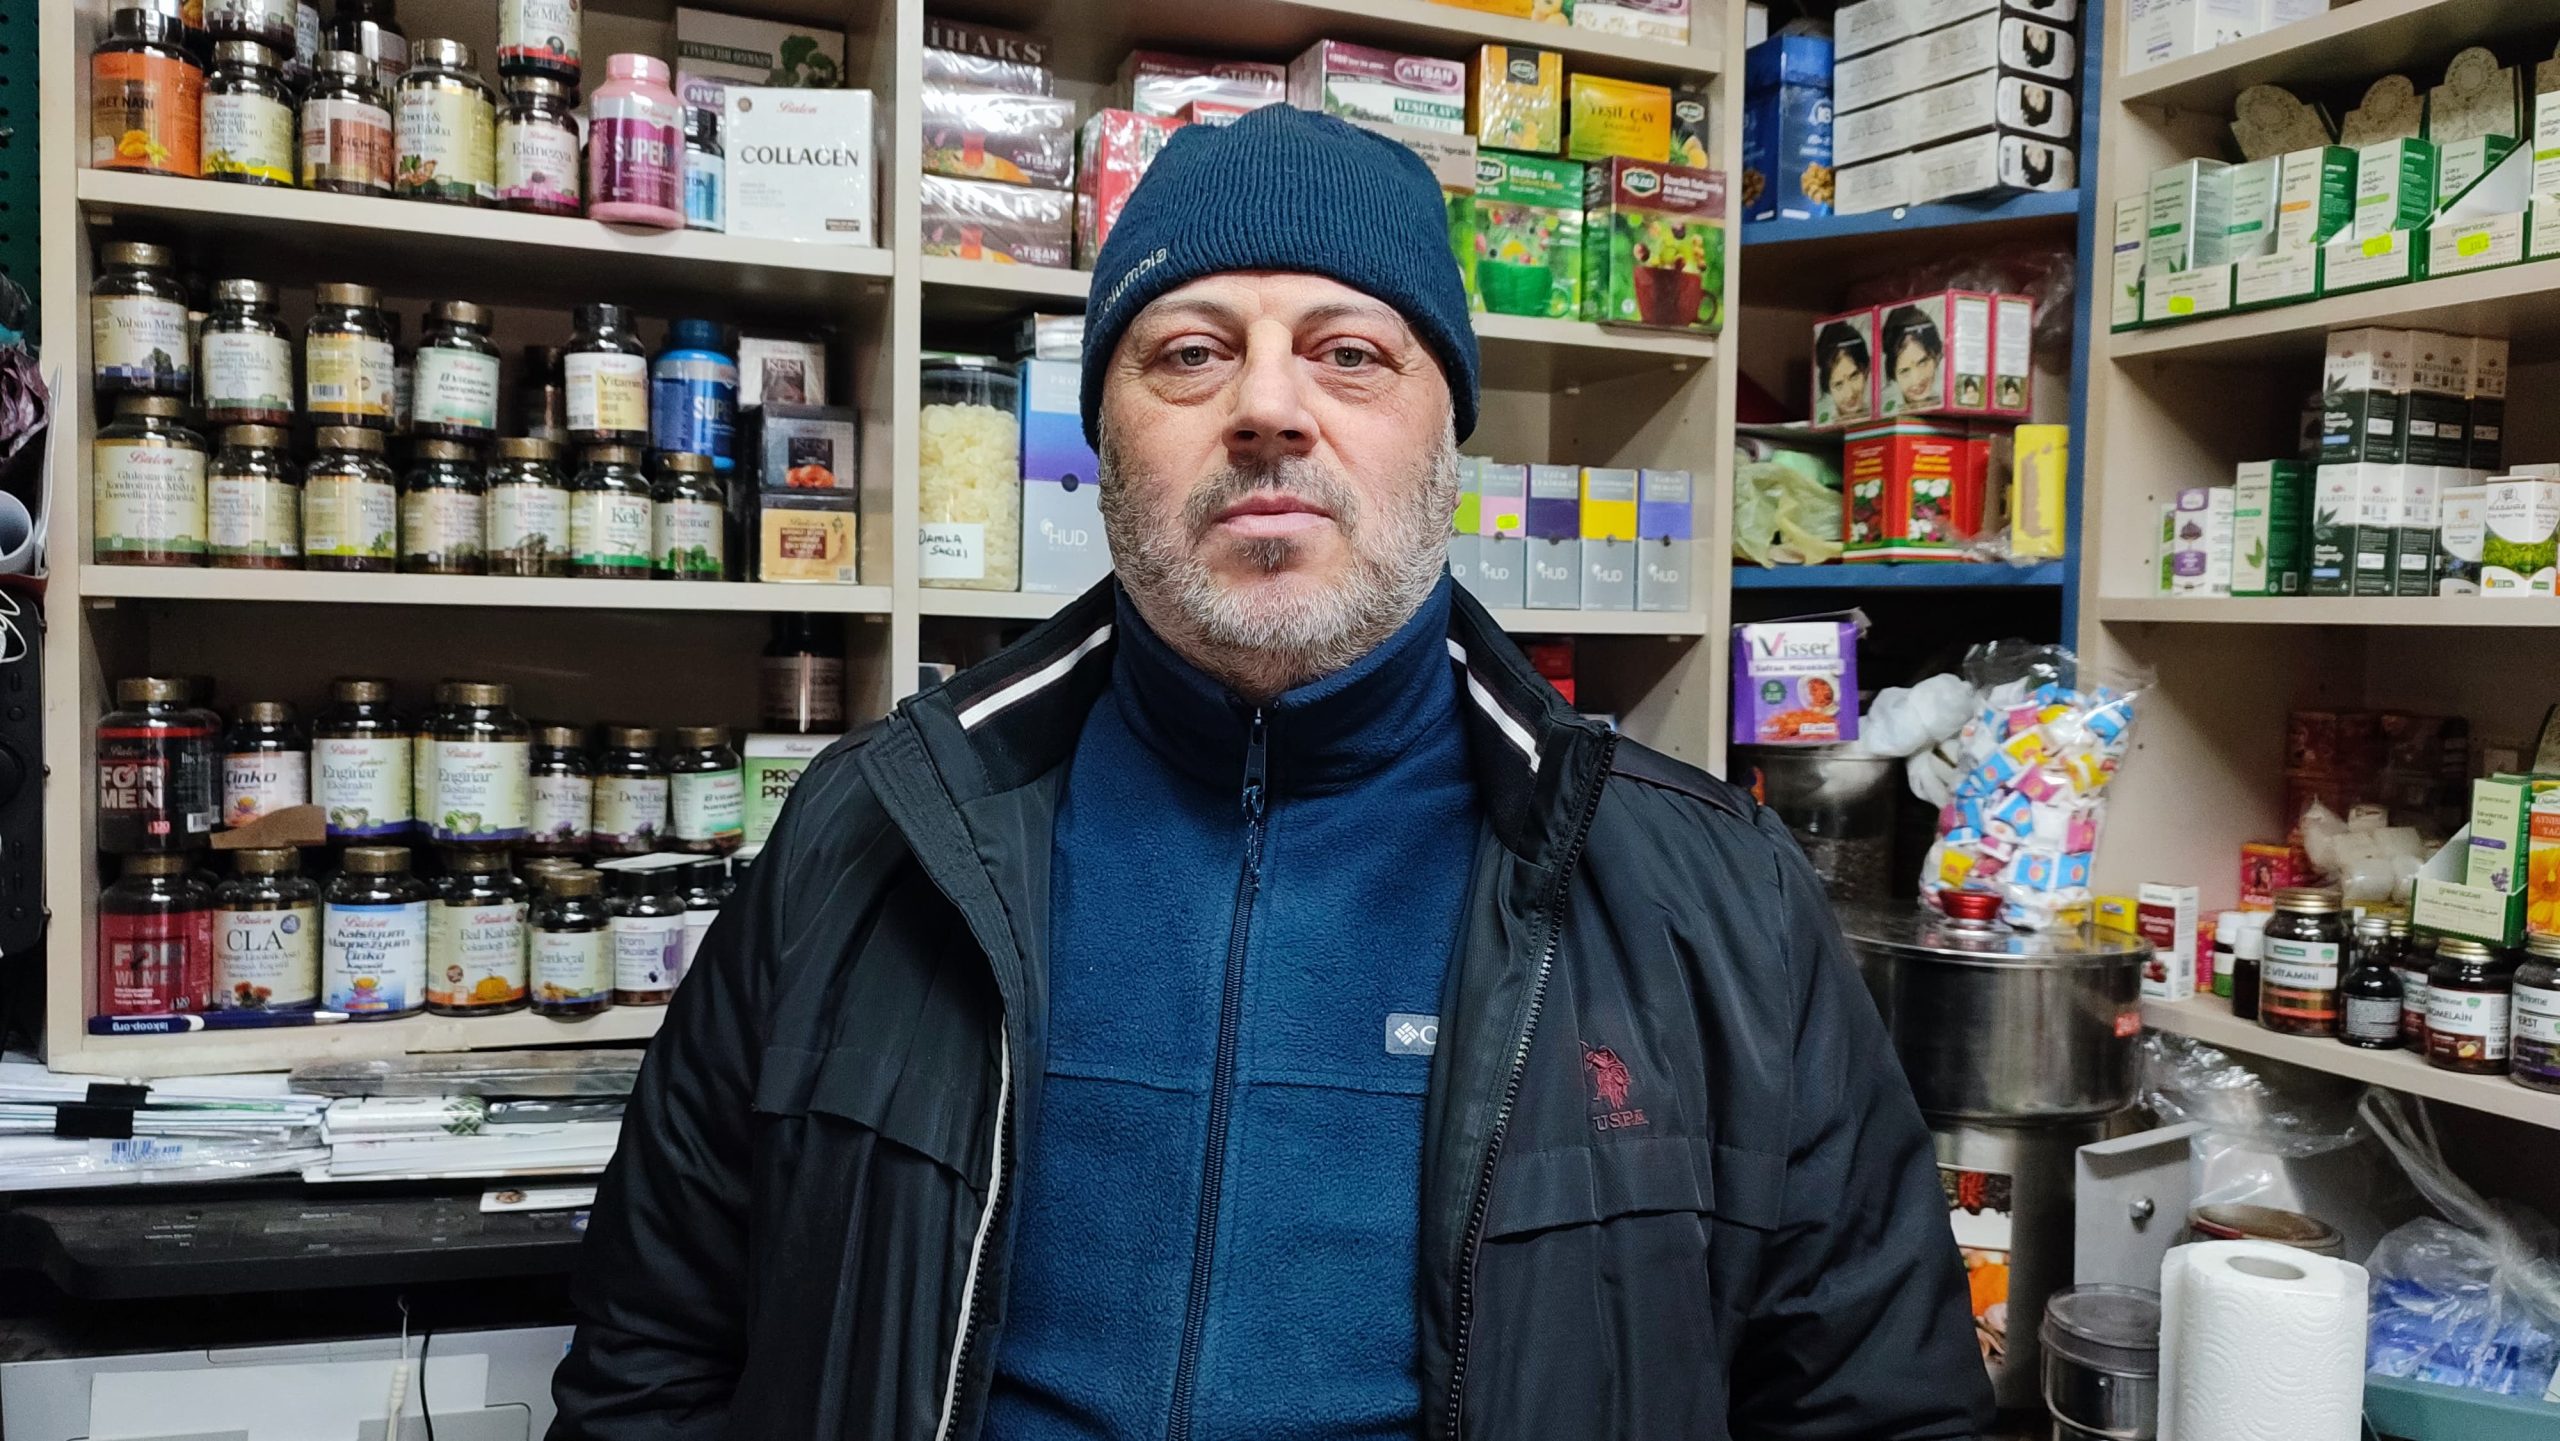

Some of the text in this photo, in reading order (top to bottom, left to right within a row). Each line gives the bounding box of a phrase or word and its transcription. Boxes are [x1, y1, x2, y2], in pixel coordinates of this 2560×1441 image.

[512, 141, 572, 164] Ekinezya
[740, 145, 859, 168] COLLAGEN
[610, 506, 643, 528] Kelp
[1049, 528, 1089, 546] HUD
[1541, 566, 1569, 582] HUD
[1597, 568, 1623, 583] HUD
[1652, 568, 1679, 583] HUD
[1758, 632, 1830, 658] Visser
[322, 764, 378, 784] Enginar
[437, 768, 493, 787] Enginar
[101, 788, 163, 810] MEN
[226, 929, 283, 952] CLA
[1592, 1108, 1649, 1132] USPA
